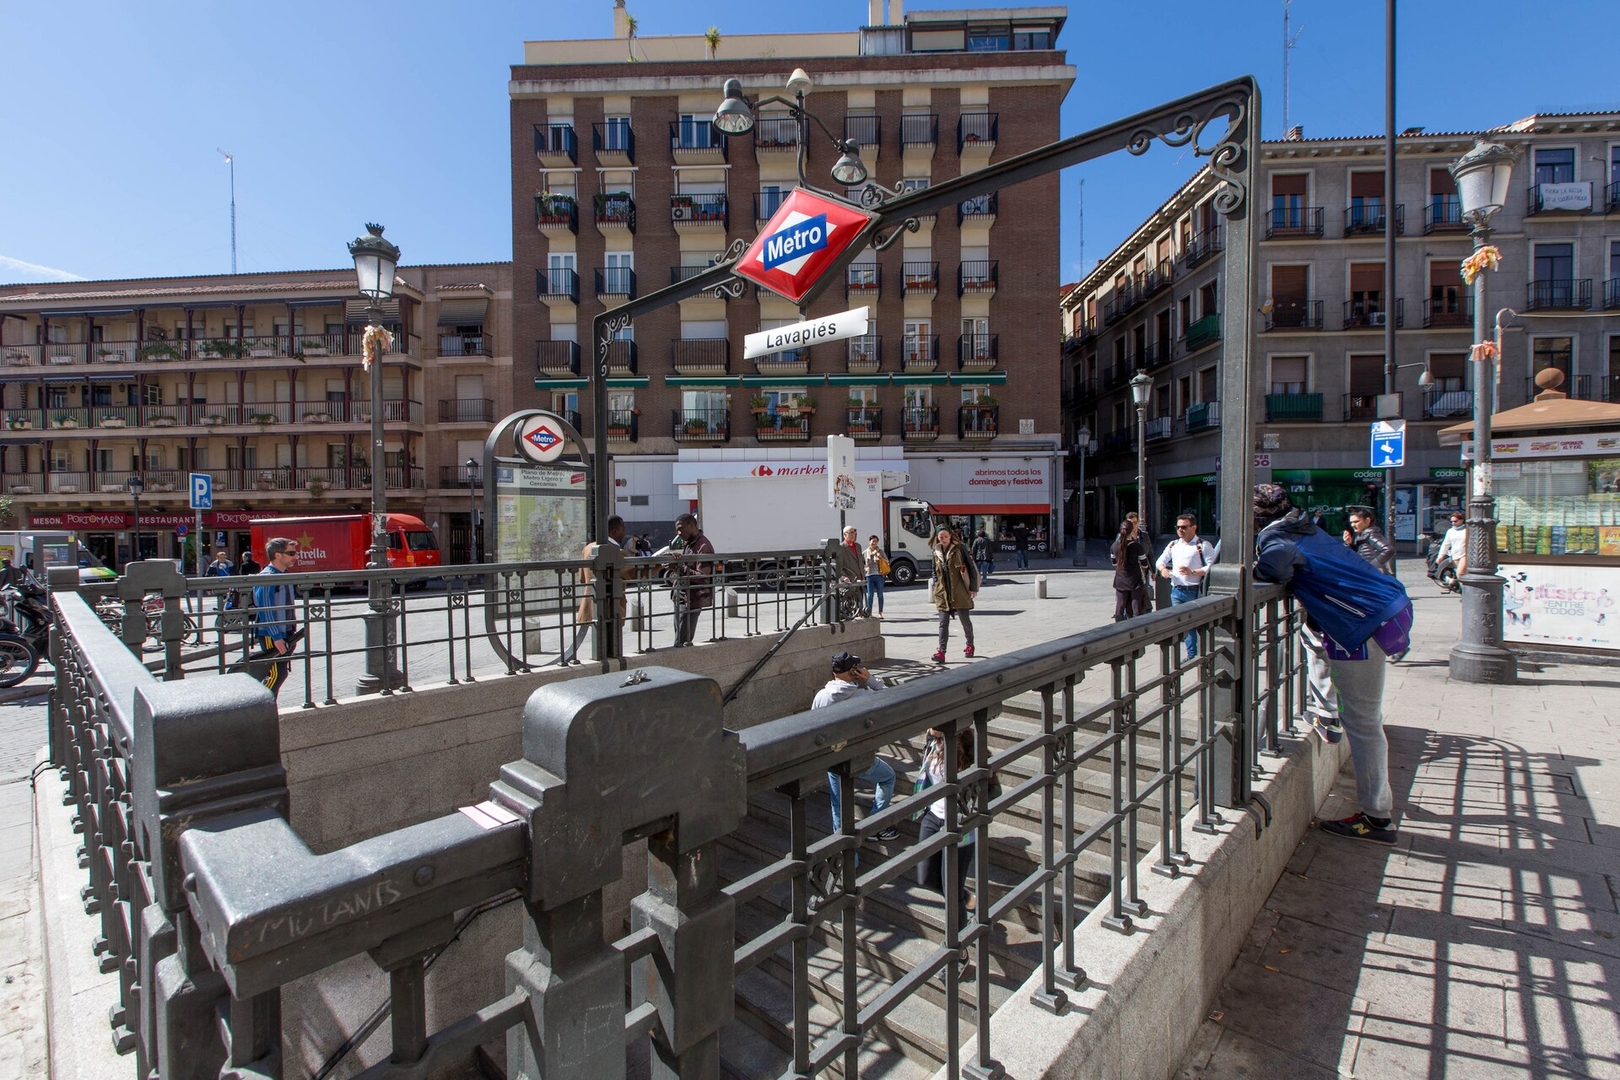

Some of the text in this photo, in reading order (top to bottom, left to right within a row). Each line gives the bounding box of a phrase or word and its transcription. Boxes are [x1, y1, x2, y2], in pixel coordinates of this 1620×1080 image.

[767, 226, 822, 262] Metro
[766, 321, 837, 349] Lavapiés
[375, 439, 383, 447] 2
[533, 434, 554, 443] Metro
[777, 464, 827, 476] market
[975, 468, 1006, 476] abrimos
[1030, 468, 1041, 476] los
[1353, 470, 1383, 478] codere
[1435, 469, 1465, 478] codere
[968, 478, 1006, 486] domingos
[195, 478, 208, 505] P
[295, 547, 327, 559] strella
[1534, 584, 1597, 601] ilusión
[1547, 600, 1585, 609] ENTRE
[1544, 607, 1585, 616] TODOS
